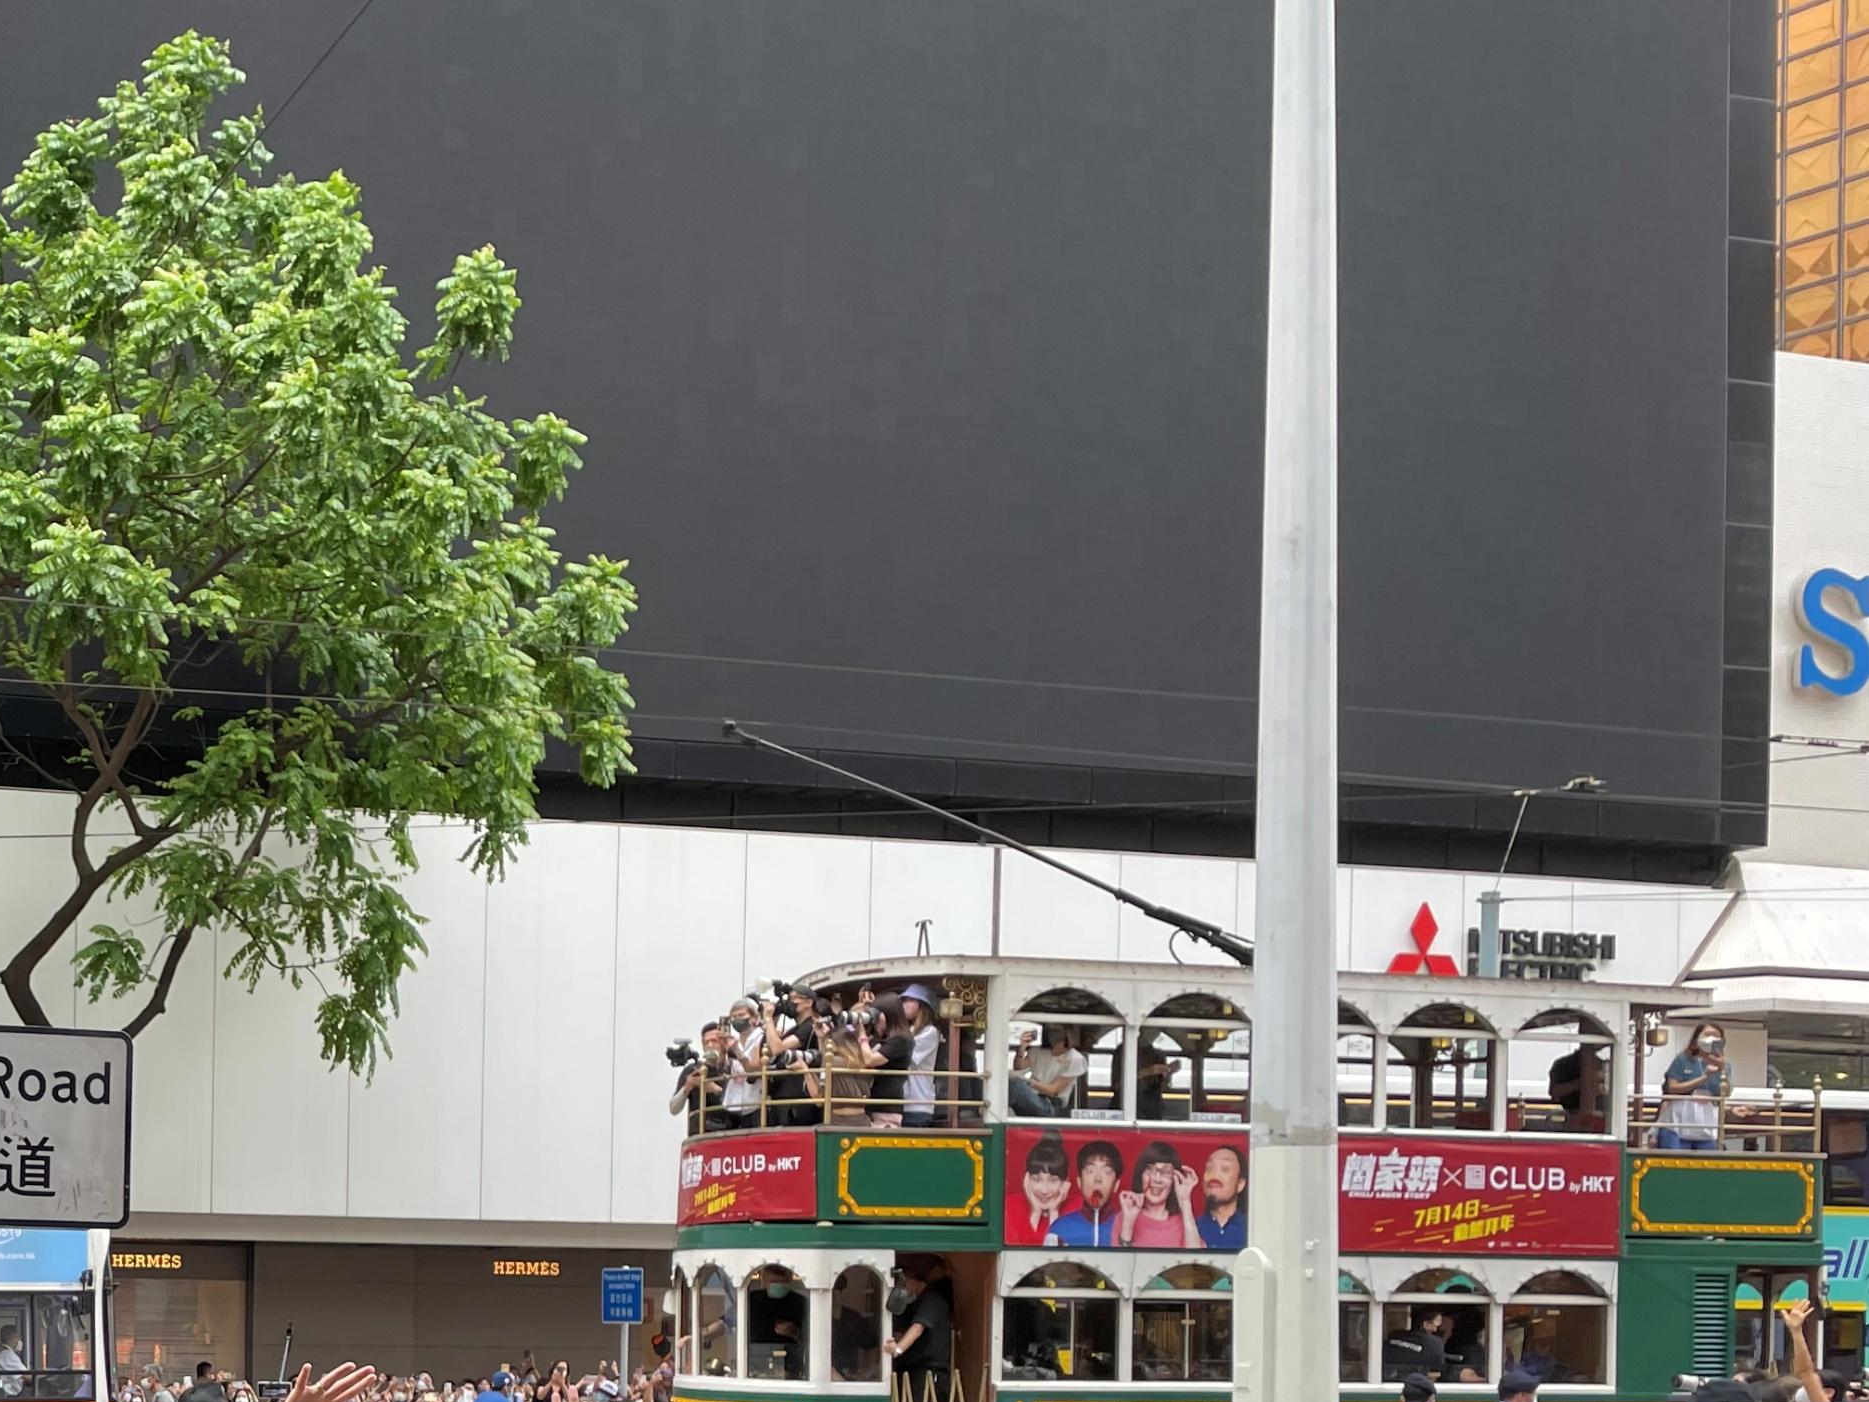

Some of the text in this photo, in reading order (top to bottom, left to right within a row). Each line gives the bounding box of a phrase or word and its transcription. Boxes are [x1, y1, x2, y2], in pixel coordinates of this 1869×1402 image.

[722, 1154, 766, 1175] CLUB
[777, 1156, 802, 1171] HKT
[1490, 1165, 1615, 1194] CLUB by HKT
[1414, 1199, 1480, 1229] 7月14日
